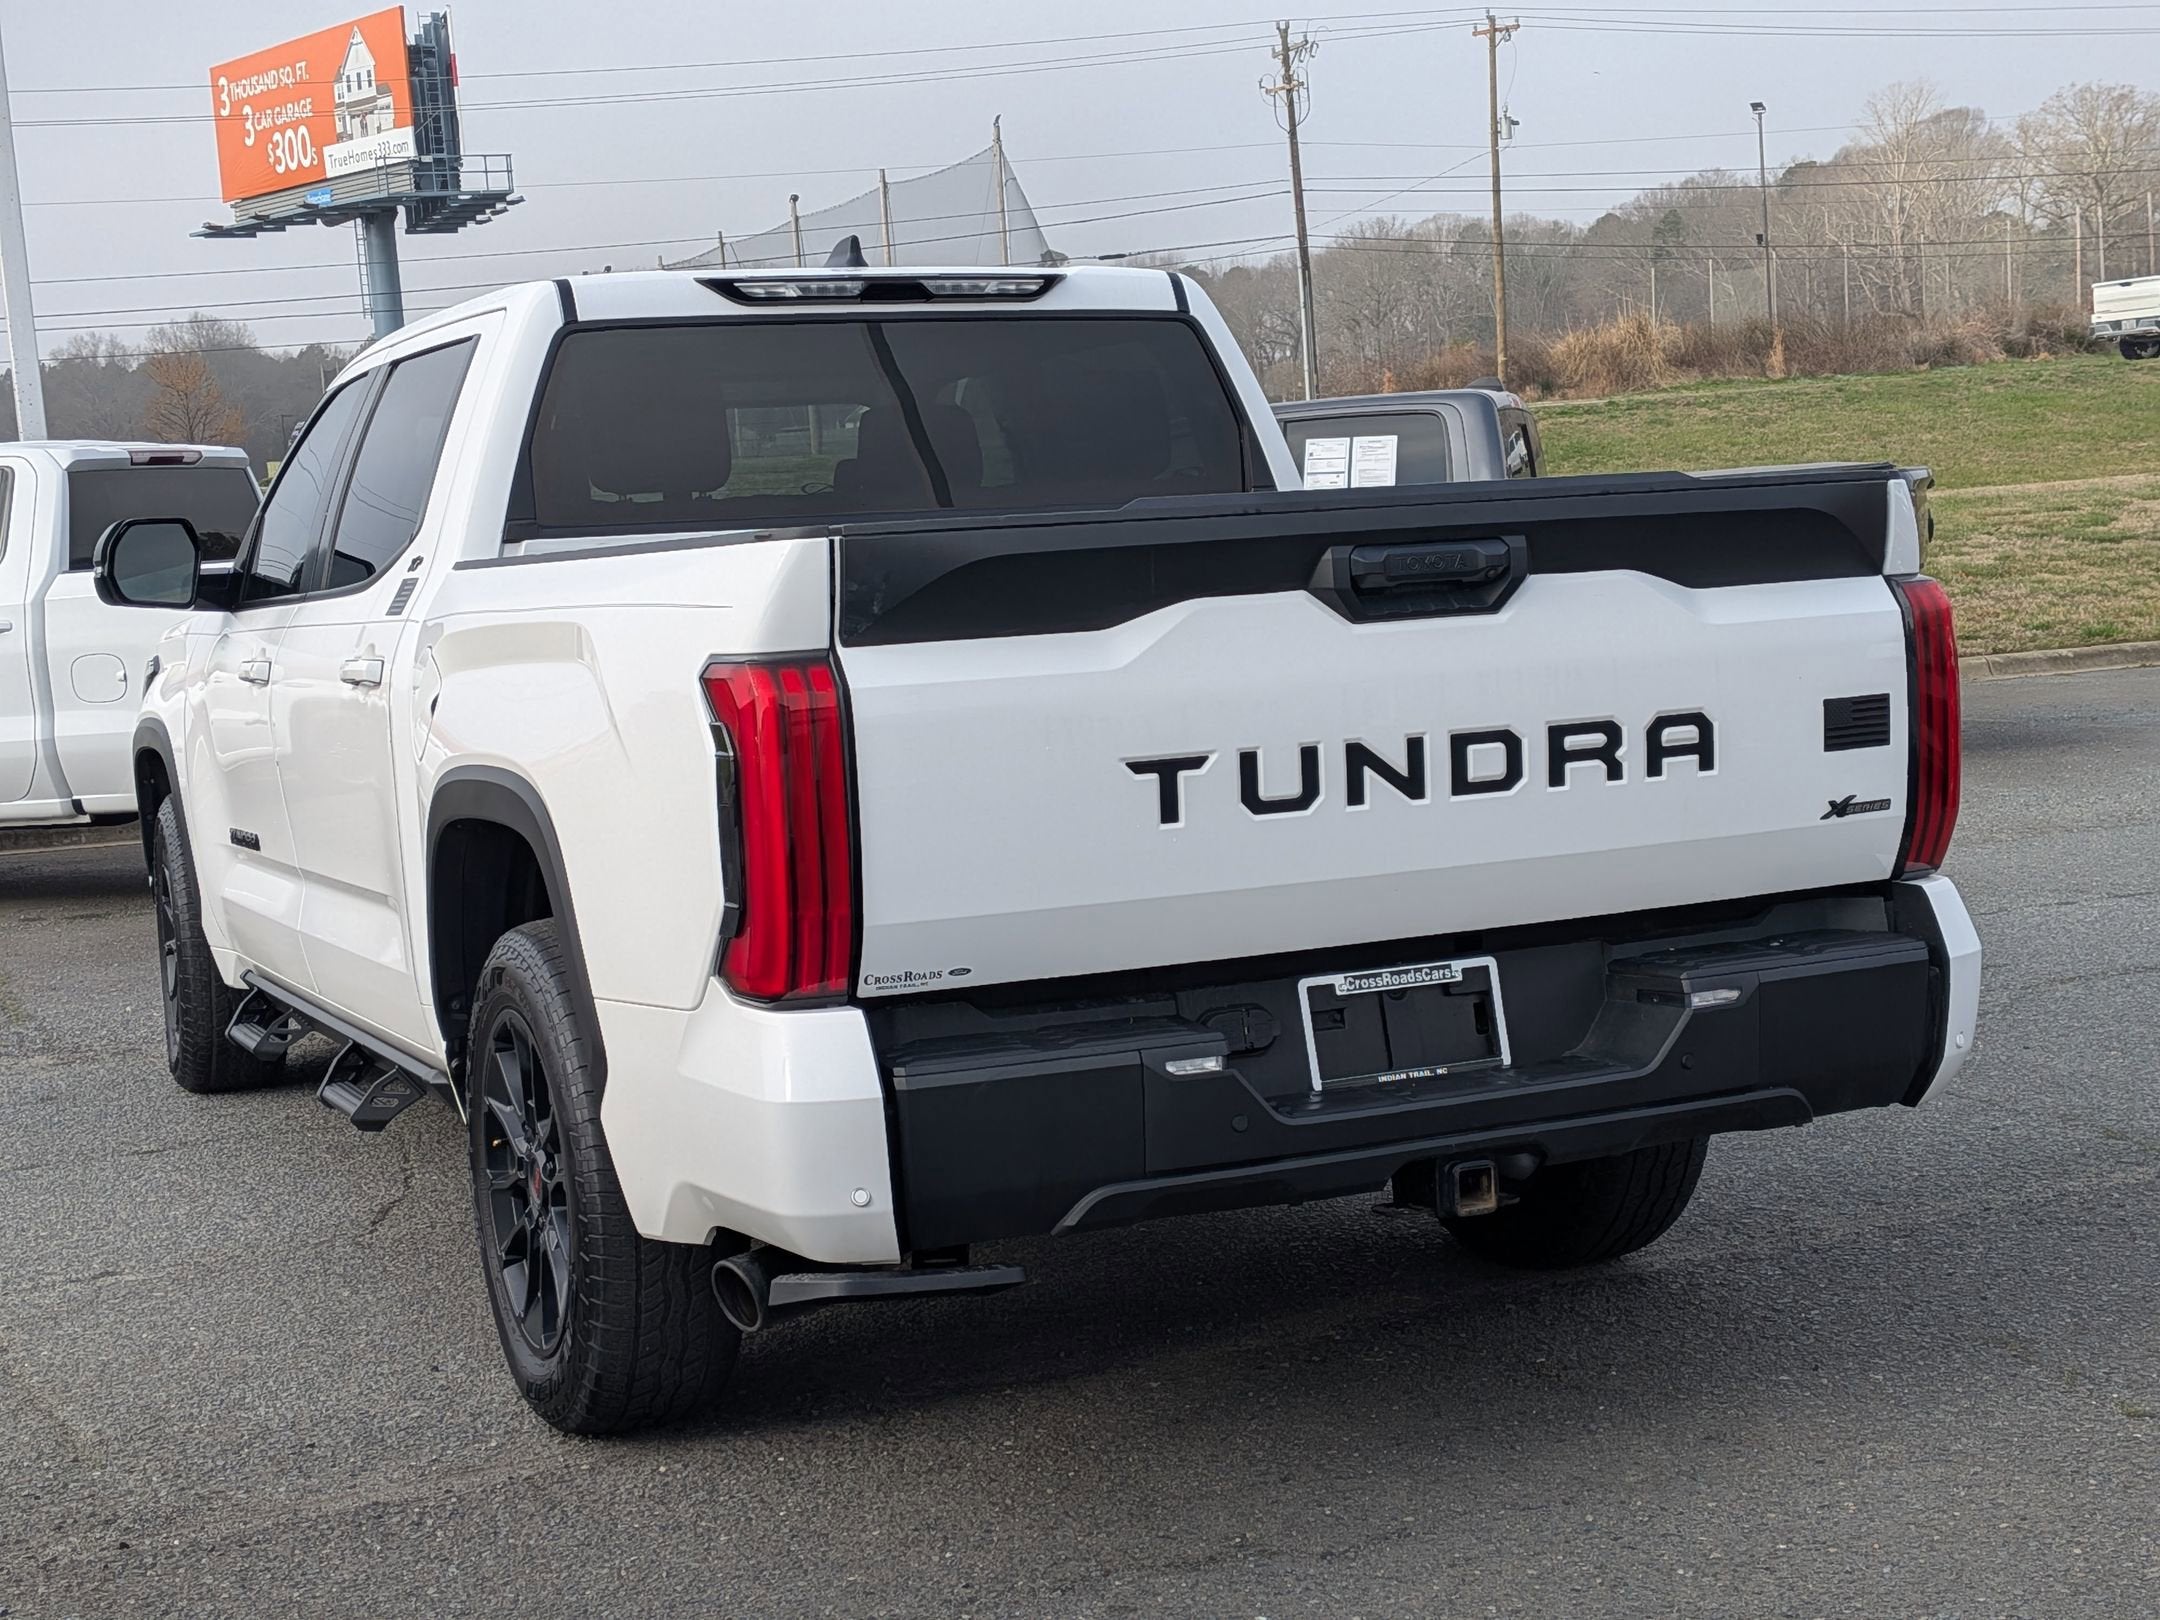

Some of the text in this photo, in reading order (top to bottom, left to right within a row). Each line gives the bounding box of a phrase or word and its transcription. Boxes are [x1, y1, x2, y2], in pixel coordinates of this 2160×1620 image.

[218, 76, 231, 117] 3
[229, 69, 278, 102] THOUSAND
[295, 61, 309, 81] FT.
[242, 97, 313, 147] 3 CAR GARAGE
[328, 140, 409, 168] TrueHomes333.com
[1394, 552, 1465, 572] TOYOTA
[1123, 709, 1717, 827] TUNDRA
[1346, 968, 1451, 990] CrossRoadsCars
[1378, 1073, 1406, 1083] INDIAN
[1436, 1067, 1448, 1075] NC
